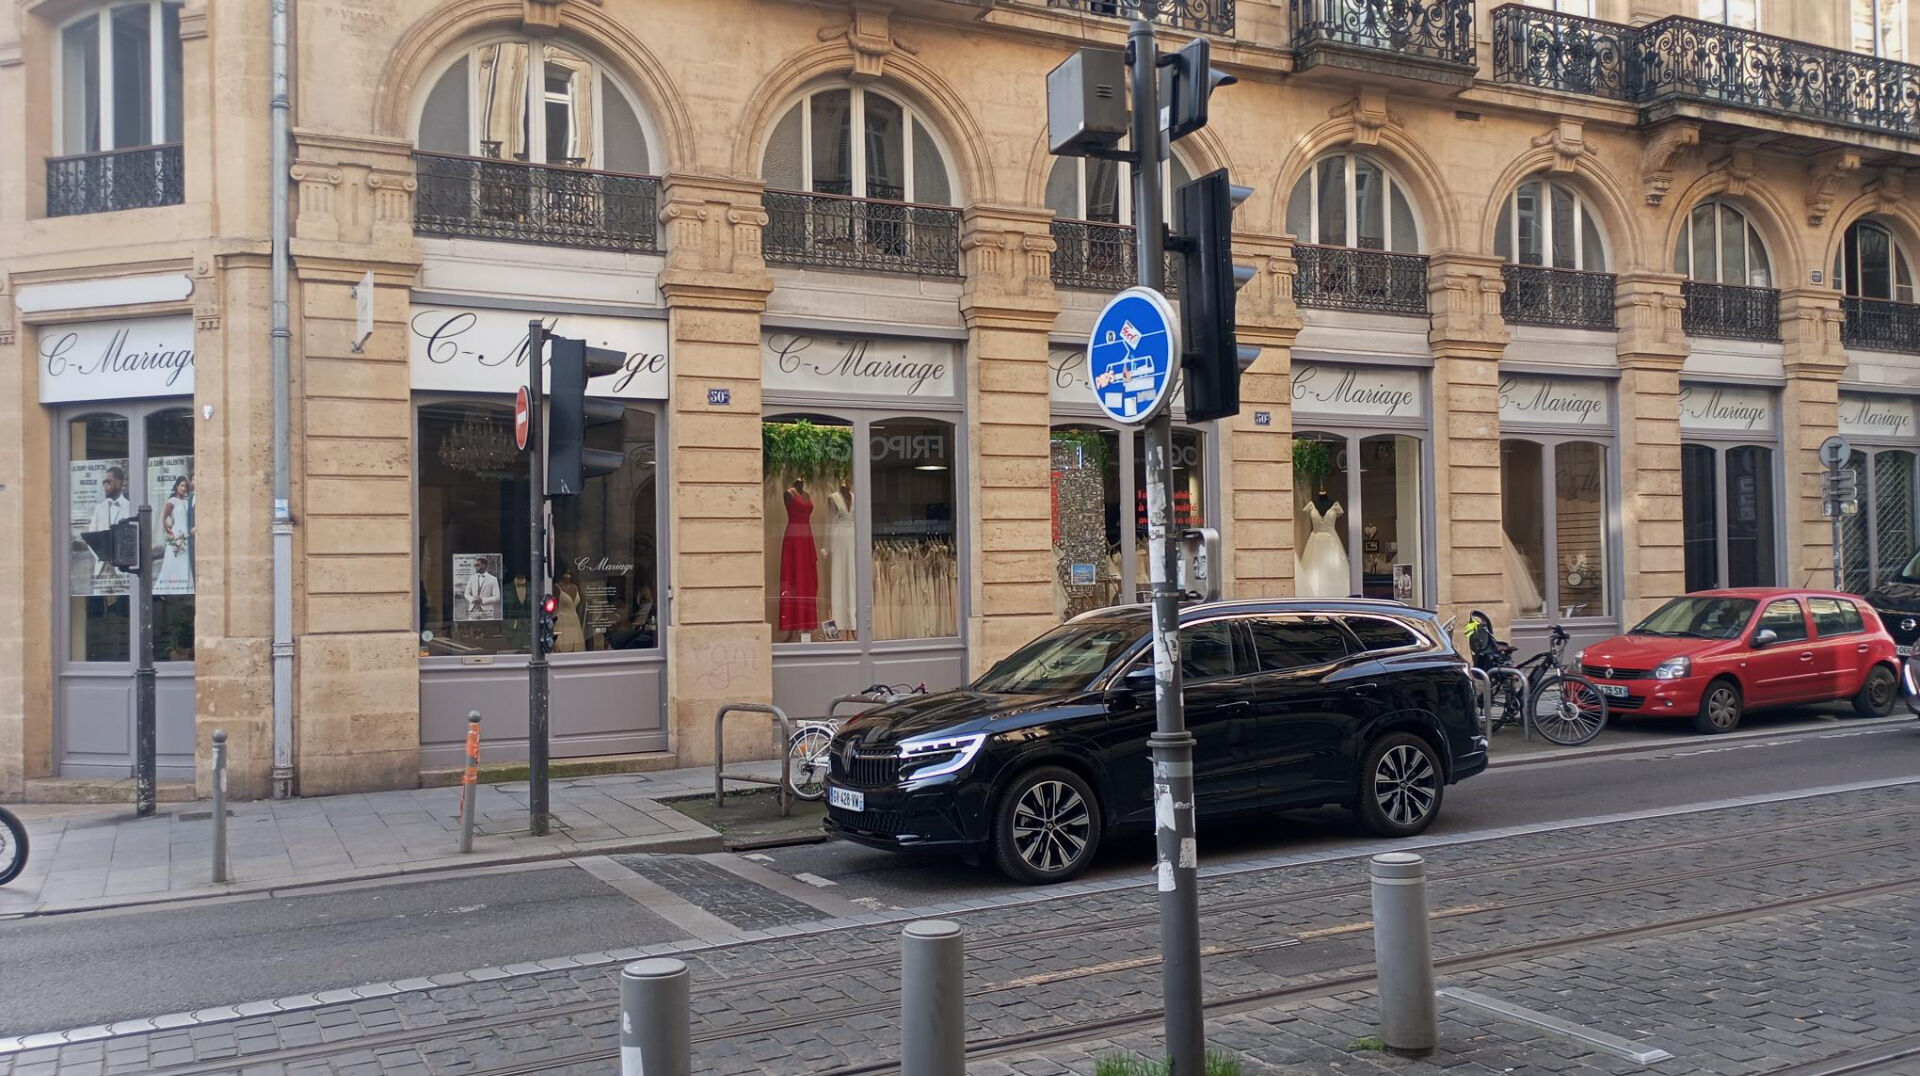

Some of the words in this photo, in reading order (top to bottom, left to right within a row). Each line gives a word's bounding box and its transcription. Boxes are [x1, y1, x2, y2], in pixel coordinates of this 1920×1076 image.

[39, 328, 195, 386] C-Mariag
[411, 310, 665, 393] C-Mge
[1838, 396, 1910, 435] -Mariage
